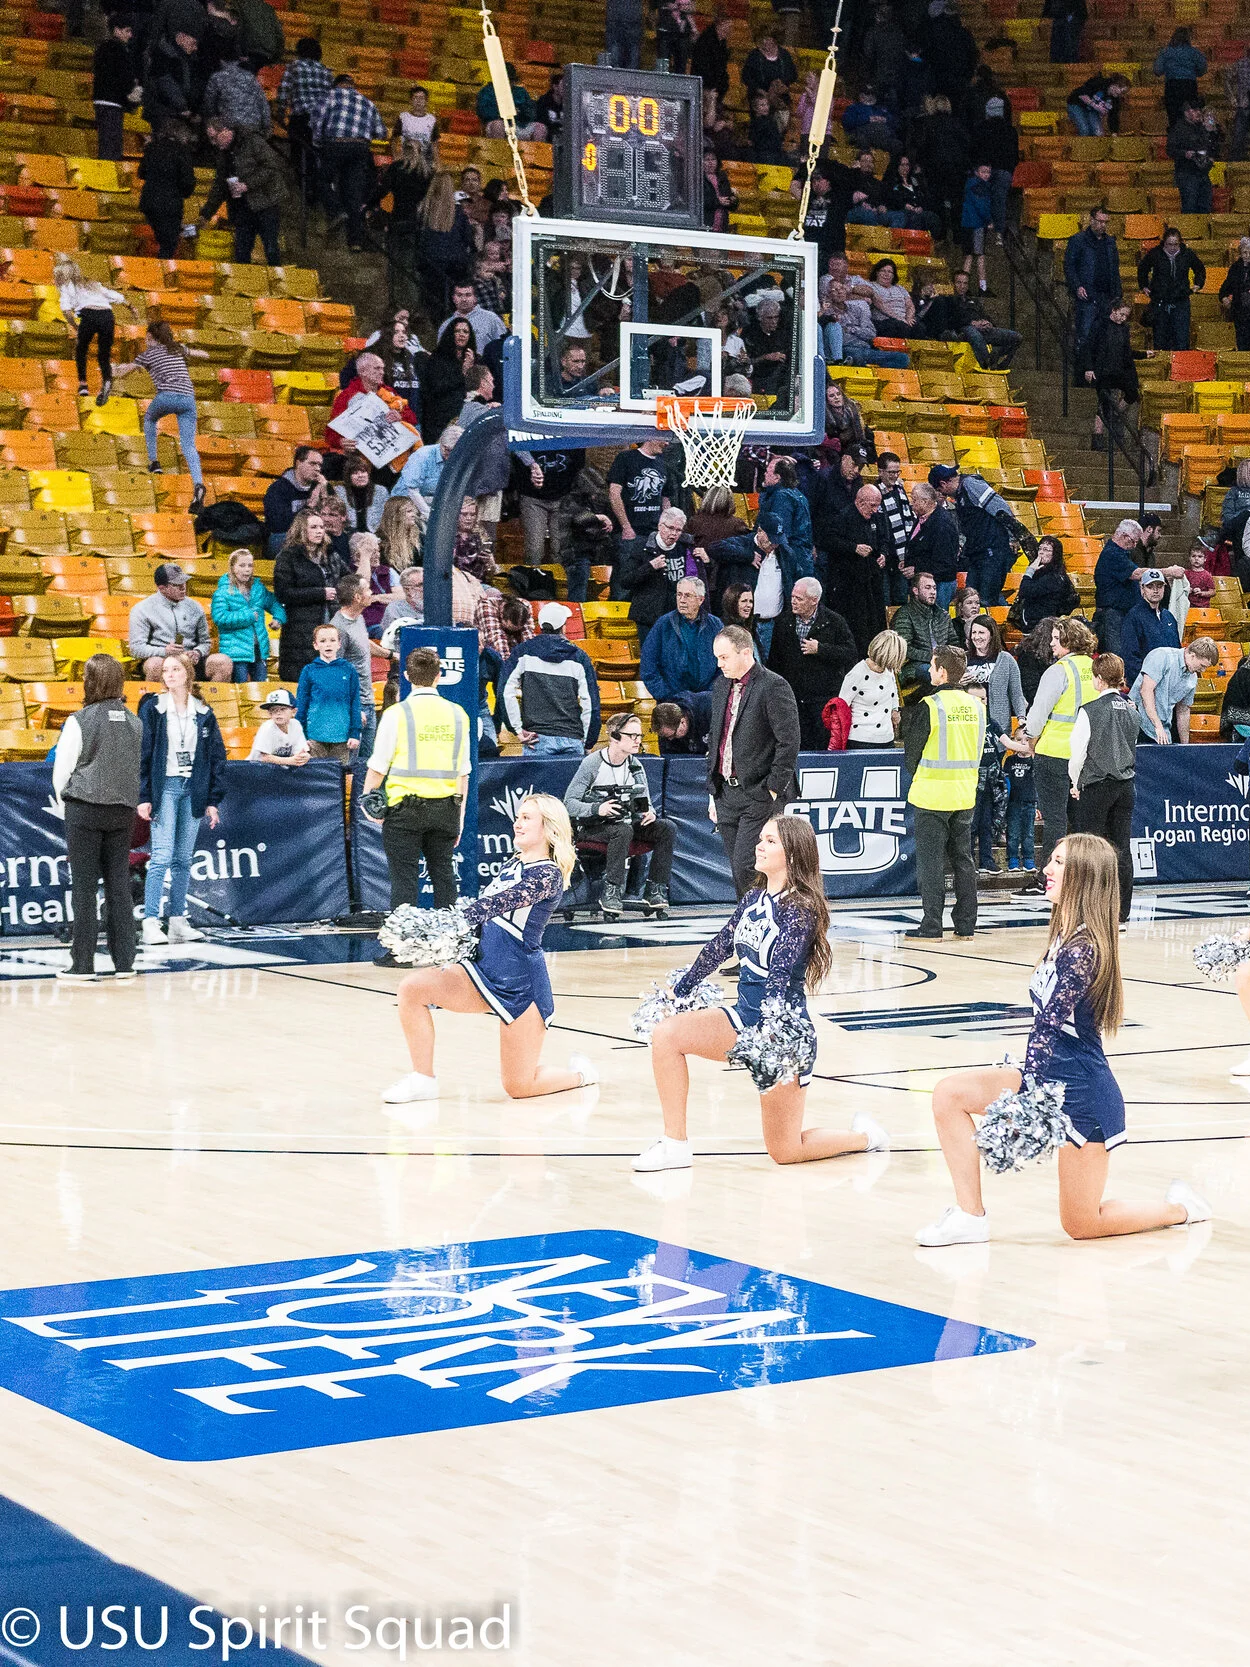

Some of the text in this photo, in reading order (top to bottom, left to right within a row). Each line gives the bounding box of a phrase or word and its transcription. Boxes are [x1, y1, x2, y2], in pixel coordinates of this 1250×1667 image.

[533, 409, 562, 419] SPALDING
[424, 724, 451, 733] GUEST
[948, 714, 978, 722] SERVICES
[418, 733, 455, 742] SERVICES
[783, 801, 908, 836] STATE
[1145, 826, 1196, 847] Logan
[405, 1253, 876, 1347] NEW
[196, 1259, 715, 1405] YORK
[2, 1290, 368, 1415] LIFE
